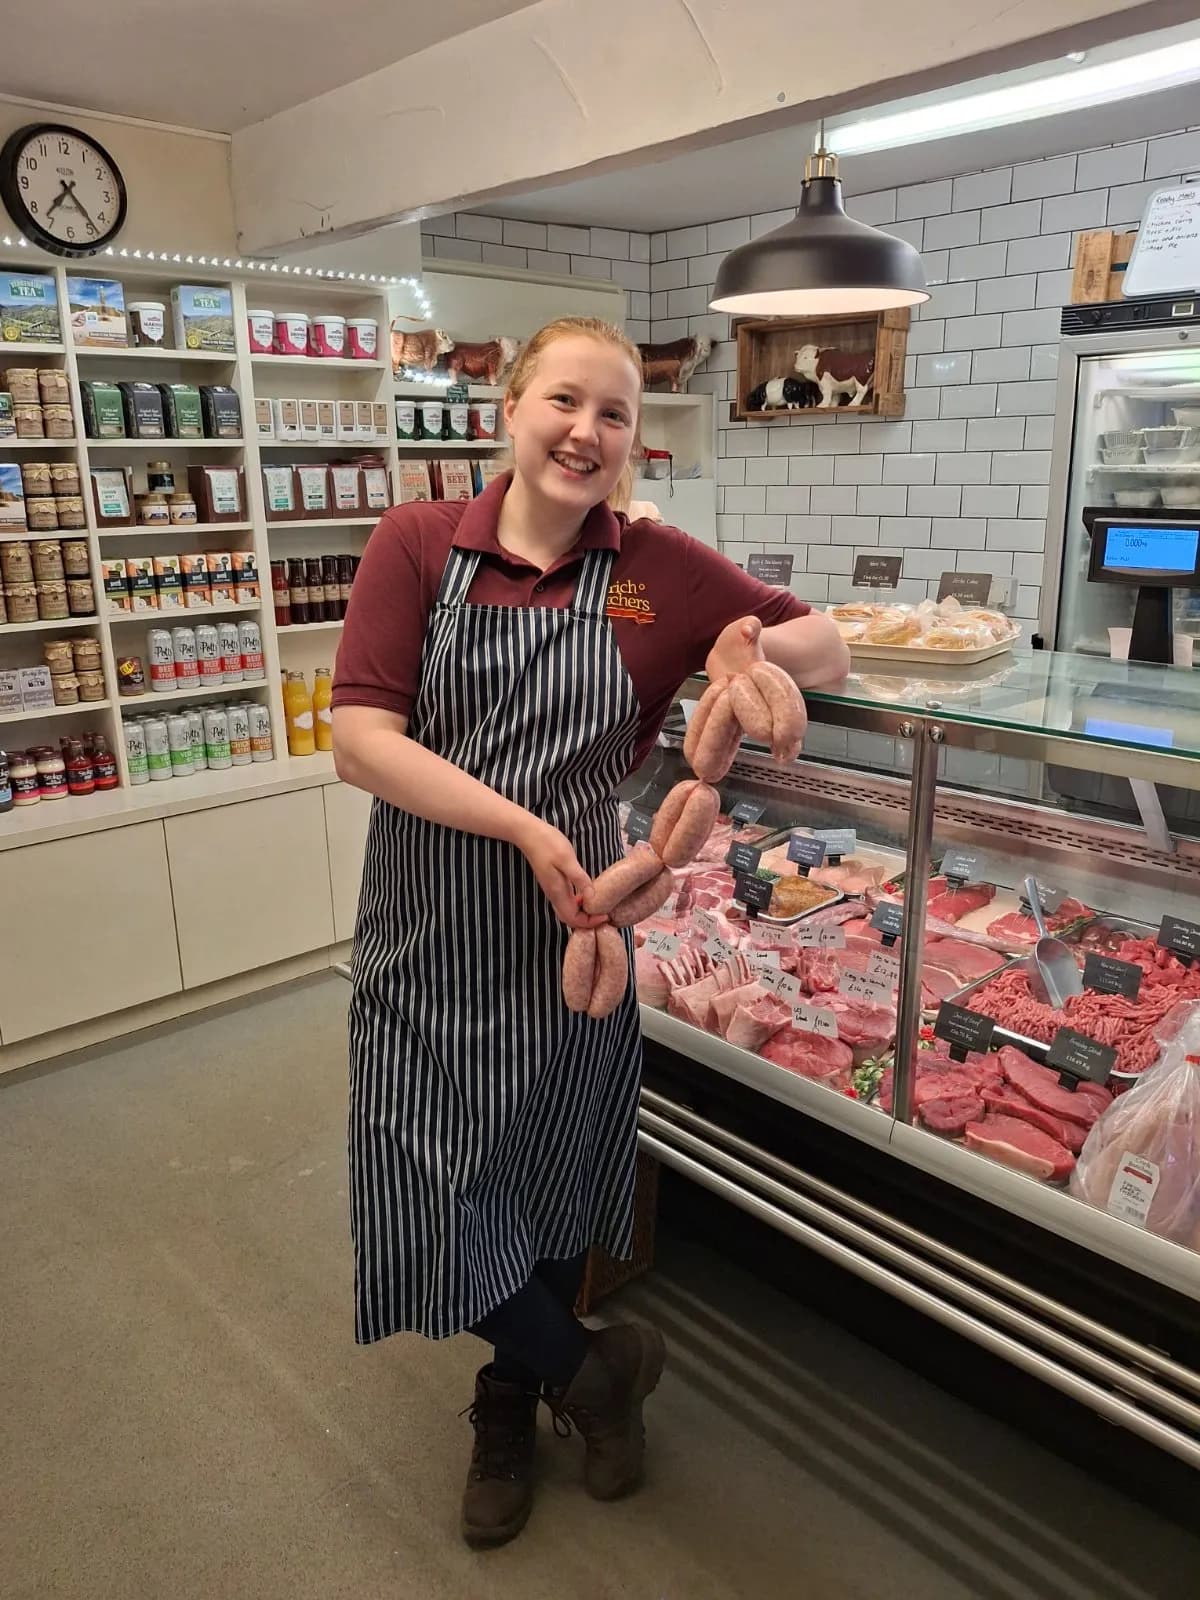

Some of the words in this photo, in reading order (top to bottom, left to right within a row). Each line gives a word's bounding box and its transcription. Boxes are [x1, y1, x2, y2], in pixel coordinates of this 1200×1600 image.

[40, 143, 47, 157] 11
[58, 141, 70, 155] 12
[81, 150, 86, 163] 1
[26, 157, 38, 171] 10
[95, 168, 103, 181] 2
[20, 176, 29, 189] 9
[103, 191, 111, 203] 3
[30, 200, 38, 213] 8
[47, 216, 55, 229] 7
[97, 211, 105, 223] 4
[66, 226, 75, 239] 6
[86, 223, 94, 235] 5
[19, 286, 37, 297] TEA
[199, 299, 216, 309] TEA
[446, 475, 469, 484] BEEF
